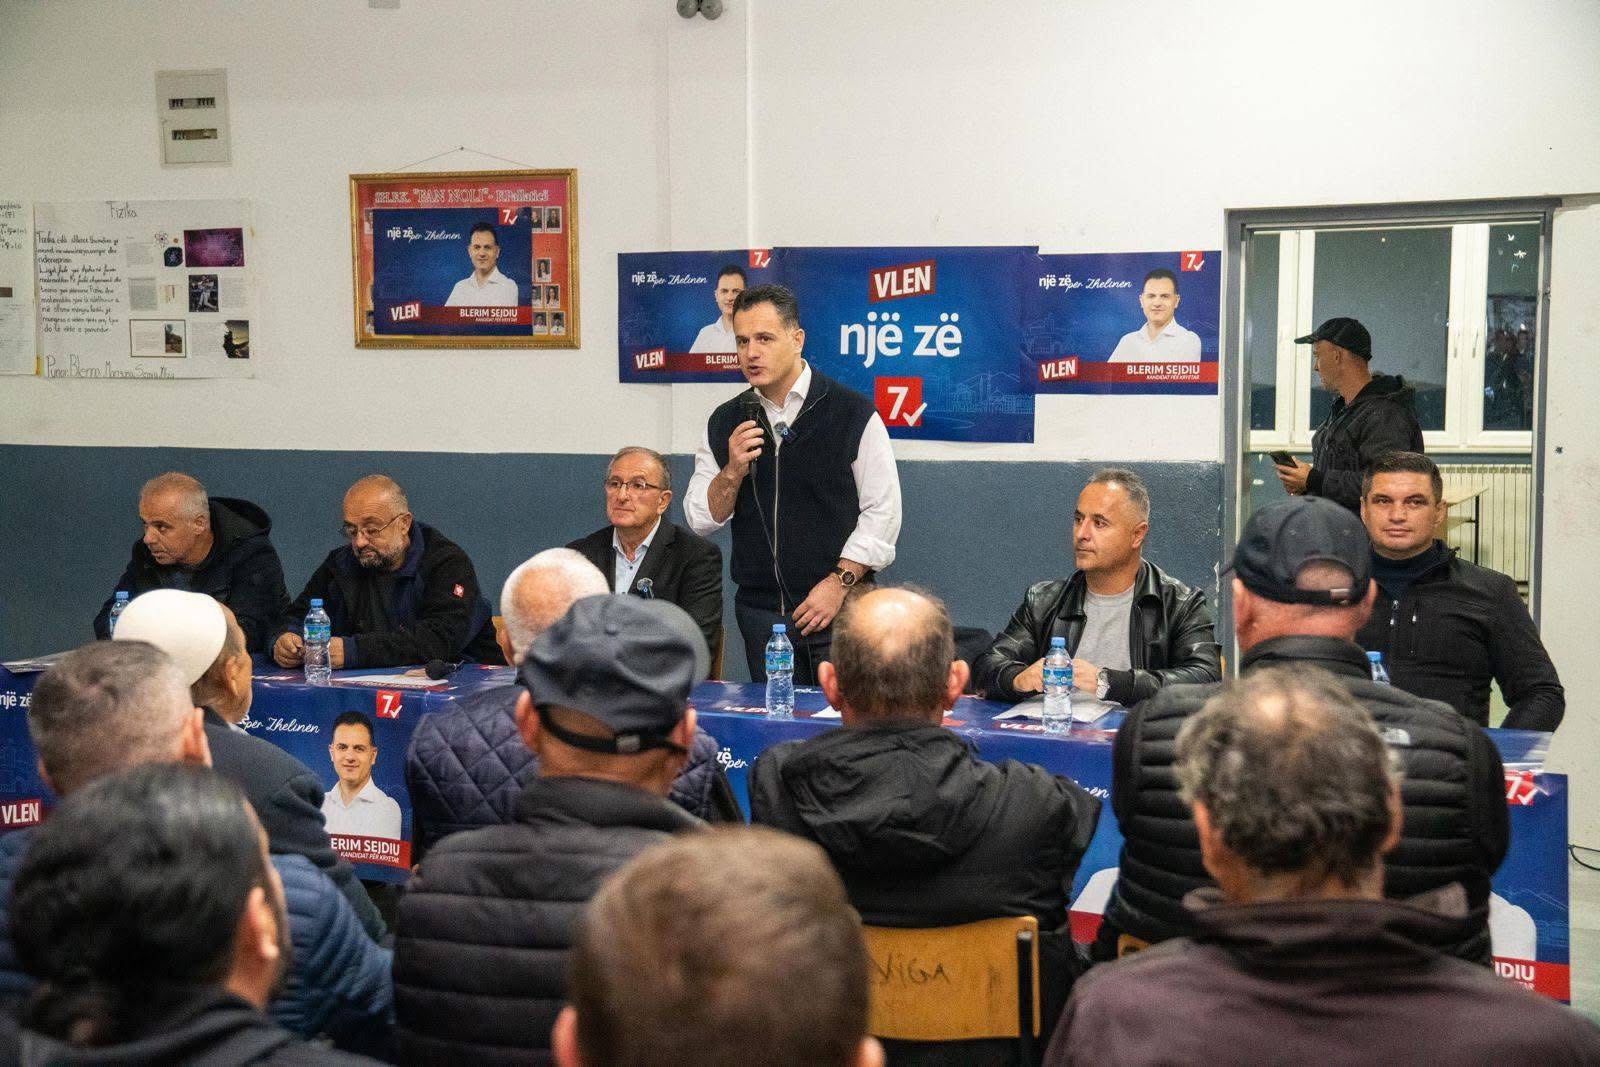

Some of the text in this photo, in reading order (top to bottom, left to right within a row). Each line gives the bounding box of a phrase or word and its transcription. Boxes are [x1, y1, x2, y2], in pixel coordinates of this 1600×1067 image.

[503, 209, 511, 223] 7
[387, 226, 402, 241] një
[402, 226, 414, 238] zë
[754, 252, 763, 266] 7
[1187, 253, 1196, 269] 7
[631, 271, 646, 286] një
[646, 271, 657, 283] zë
[874, 265, 931, 299] VLEN
[1039, 274, 1057, 290] një
[1058, 274, 1072, 287] zë
[390, 303, 419, 321] VLEN
[460, 308, 518, 318] BLERIM SEJDIU
[840, 311, 962, 368] një zë
[635, 350, 664, 369] VLEN
[706, 355, 738, 365] BLERIM
[1041, 359, 1076, 379] VLEN
[1127, 364, 1200, 376] BLERIM SEJDIU
[887, 386, 909, 420] 7
[0, 691, 32, 710] një zë
[382, 695, 393, 714] 7
[1505, 775, 1522, 799] 7
[1, 802, 39, 824] VLEN
[330, 838, 400, 856] ERIM SEJDIU
[341, 851, 369, 859] KANDIDAT
